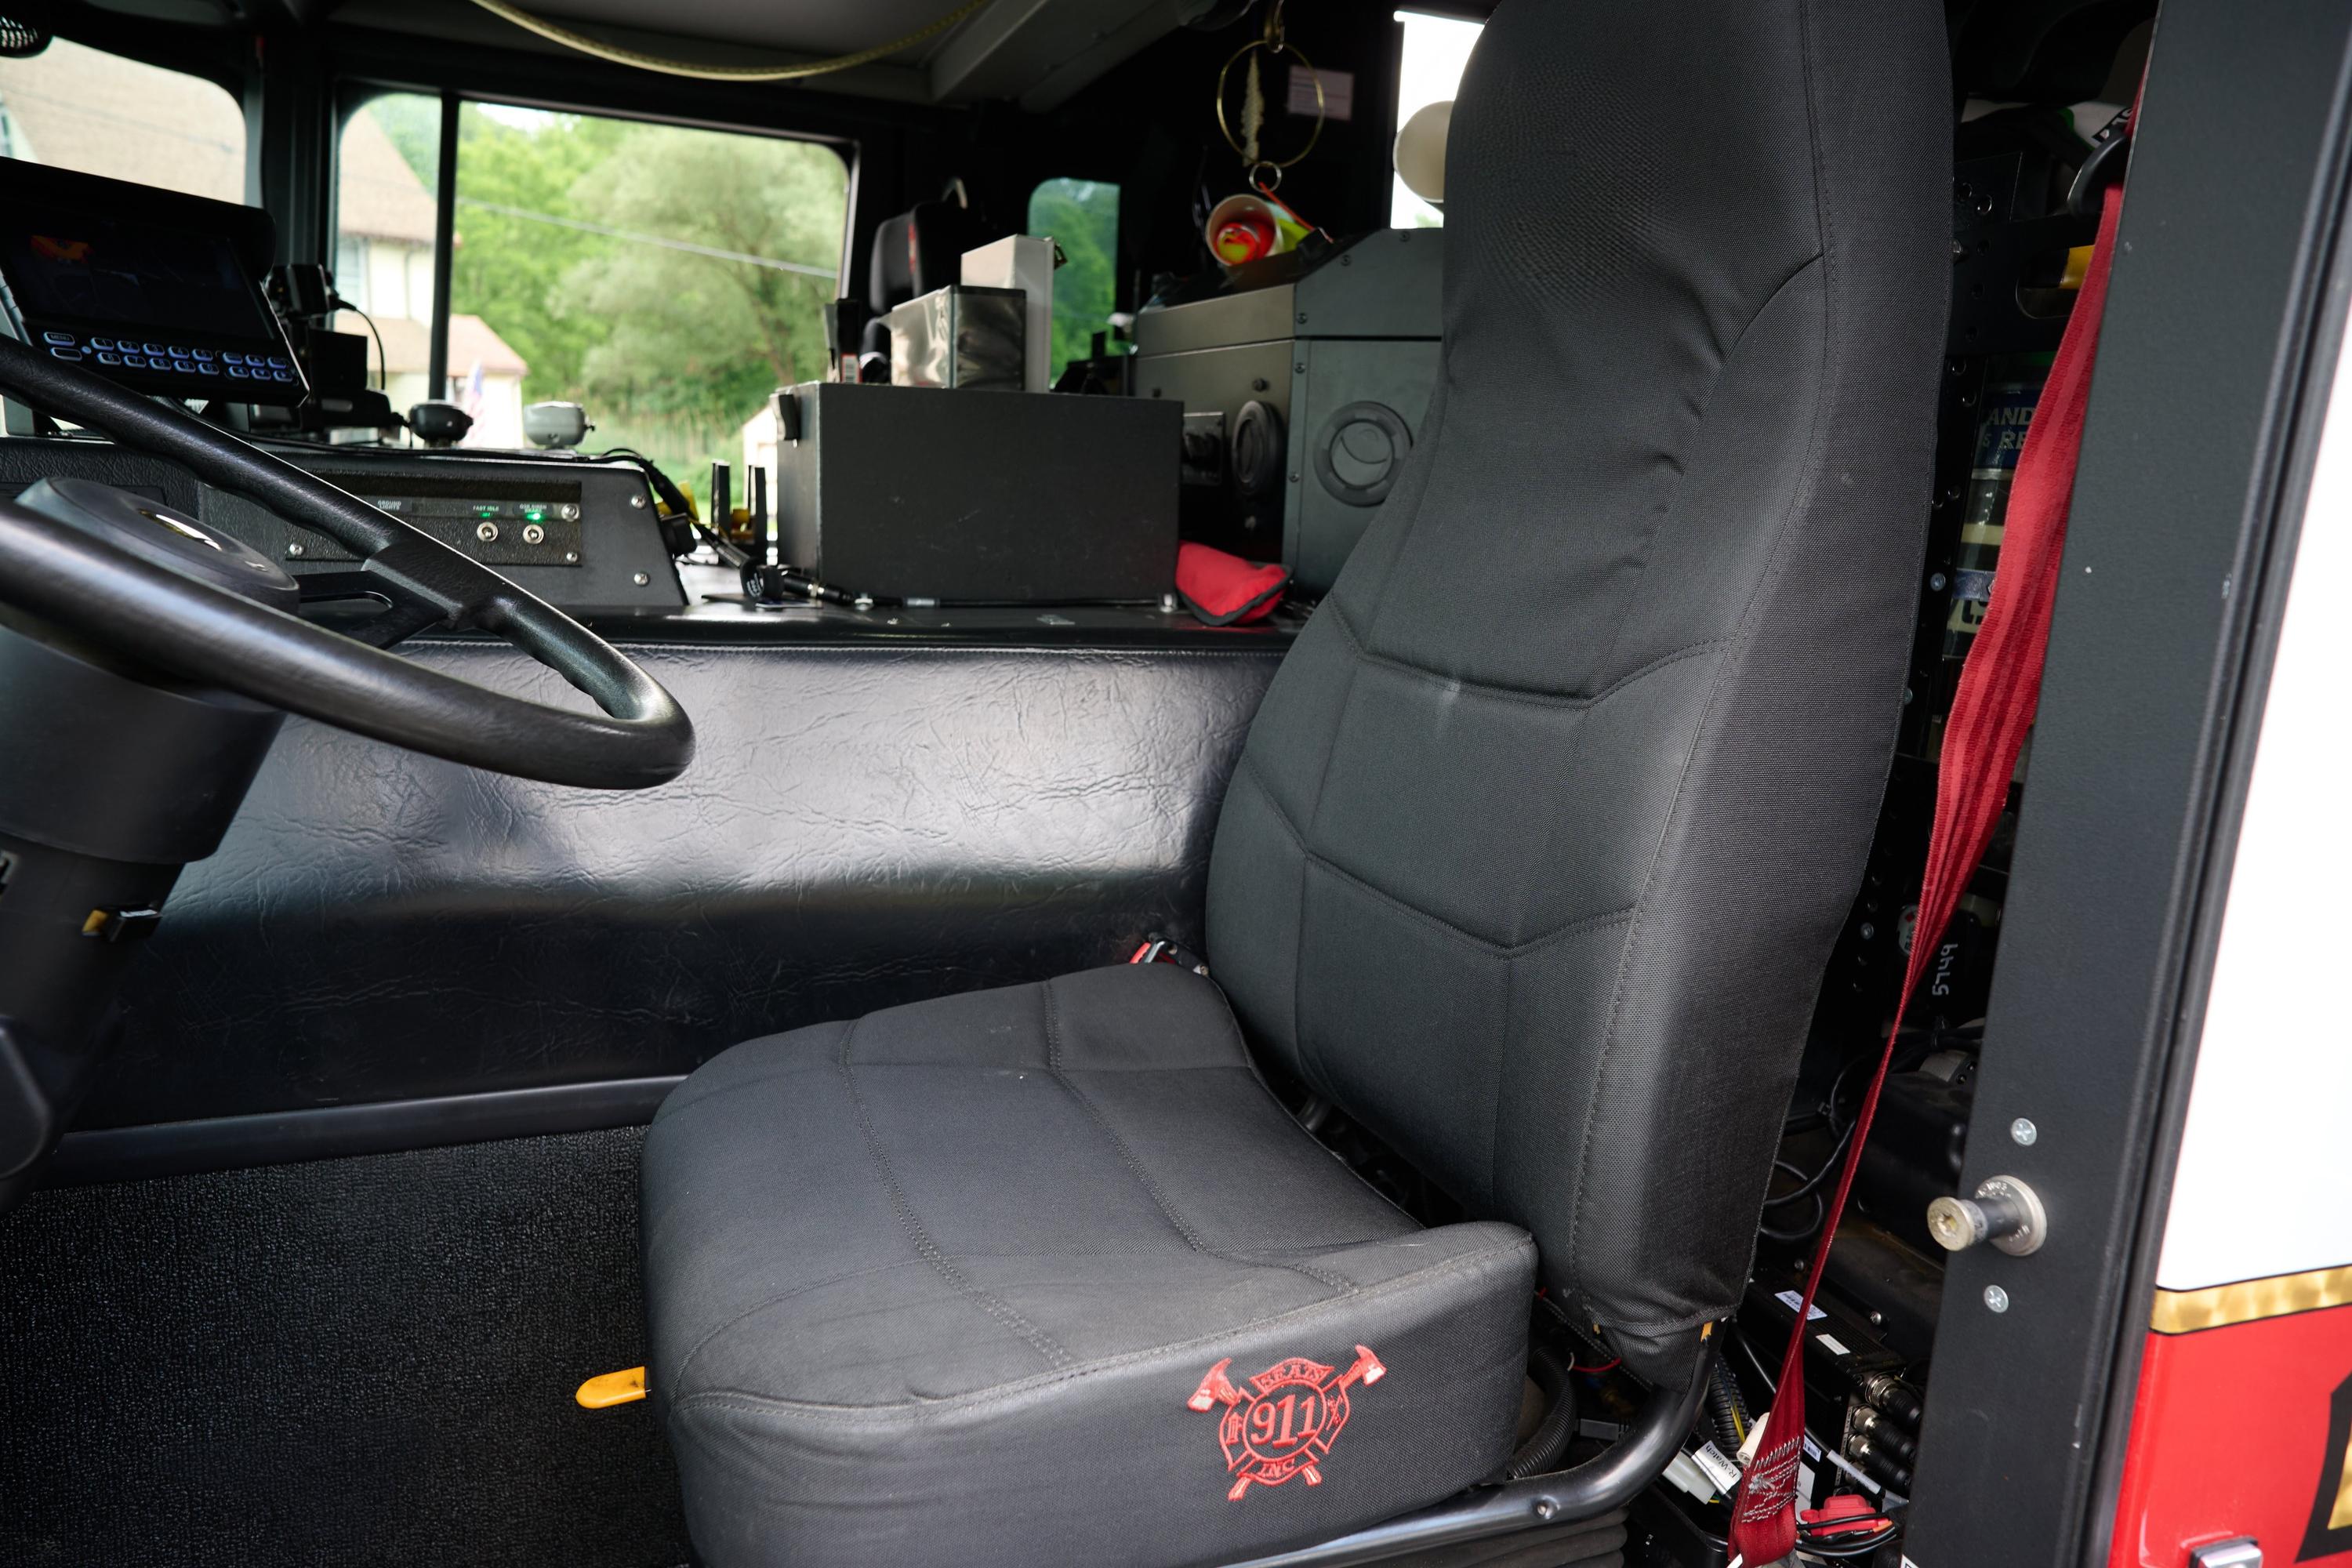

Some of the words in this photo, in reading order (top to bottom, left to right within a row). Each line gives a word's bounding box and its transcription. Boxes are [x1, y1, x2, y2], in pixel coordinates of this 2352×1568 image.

[1250, 1394, 1317, 1448] 911
[1258, 1458, 1295, 1478] INC
[1705, 1445, 1737, 1479] R-Watch
